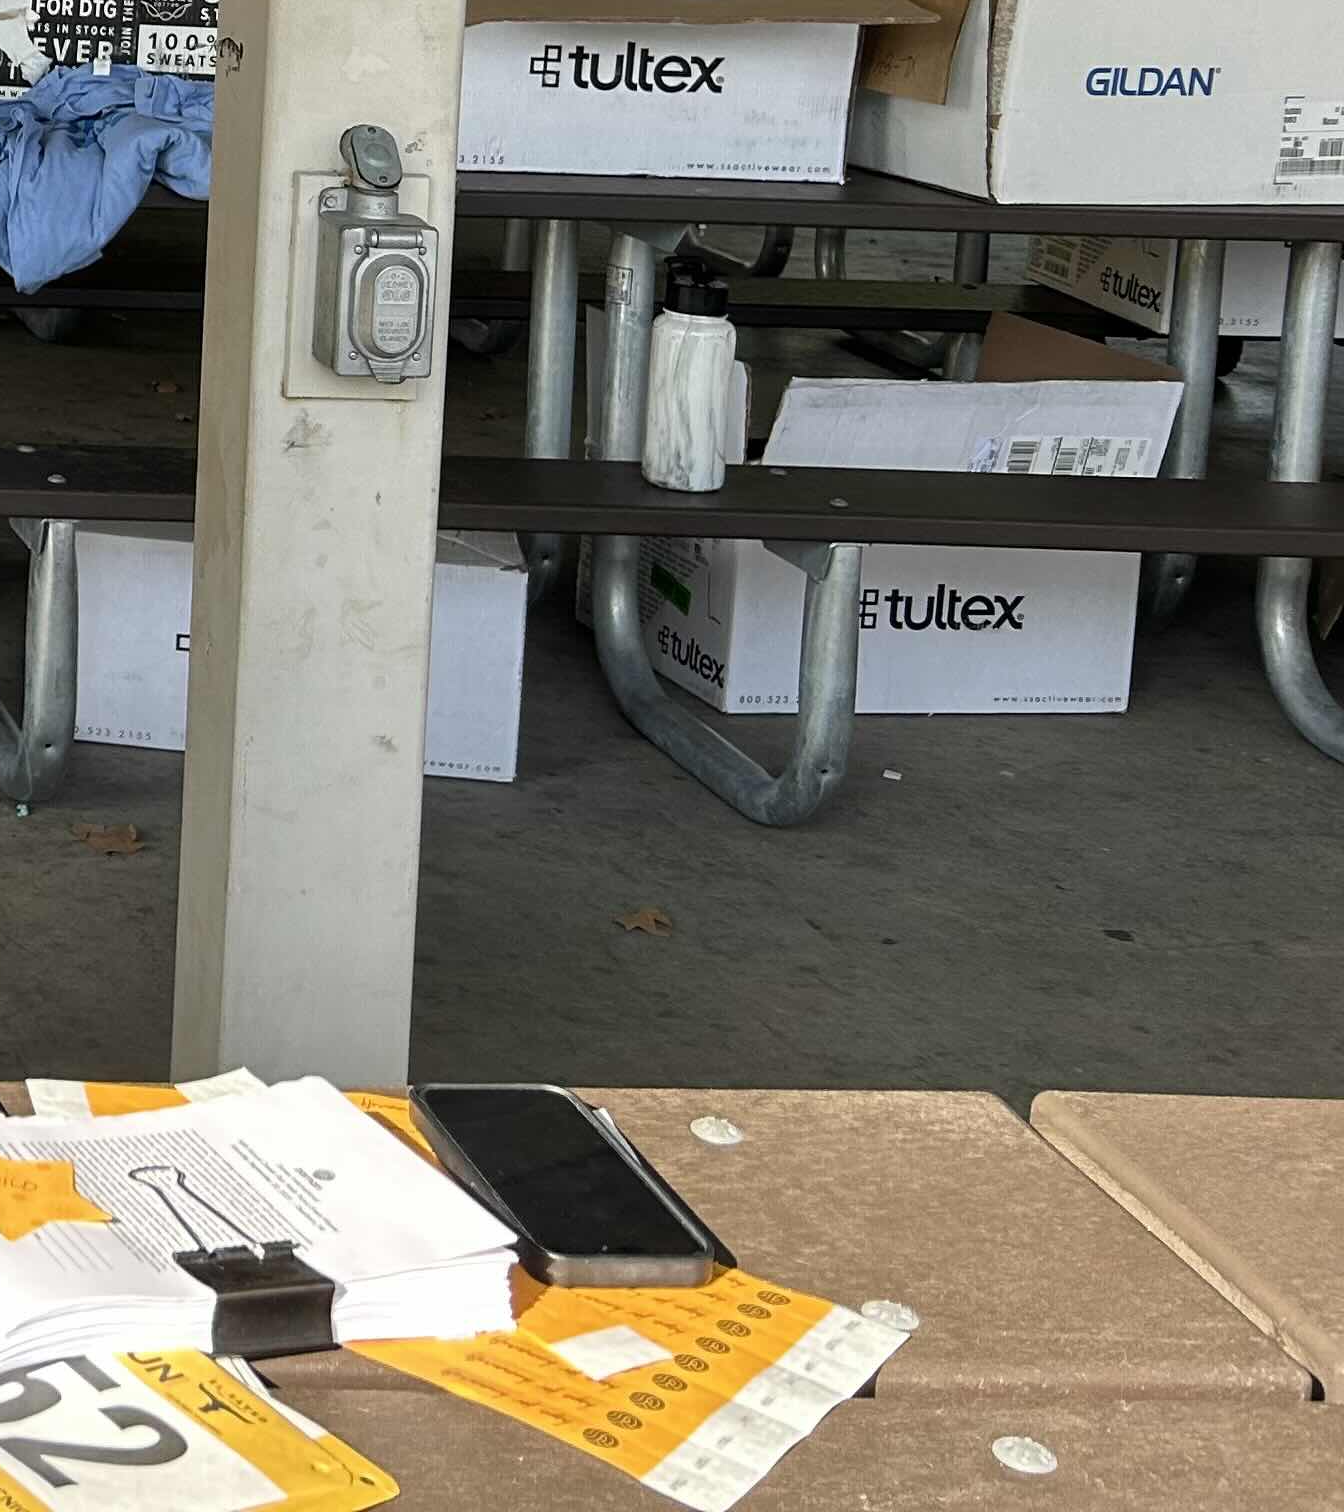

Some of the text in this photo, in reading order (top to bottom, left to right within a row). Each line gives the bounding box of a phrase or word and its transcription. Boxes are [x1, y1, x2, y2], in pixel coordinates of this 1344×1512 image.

[123, 0, 135, 22] THE
[57, 24, 69, 34] IN
[75, 25, 115, 36] STOCK
[121, 27, 132, 55] JOIN
[147, 52, 217, 68] SWEATS
[568, 41, 726, 93] tultex
[1086, 67, 1216, 96] GILDAN
[1113, 269, 1161, 313] tultex
[884, 583, 1026, 632] tultex
[670, 631, 725, 689] tultex
